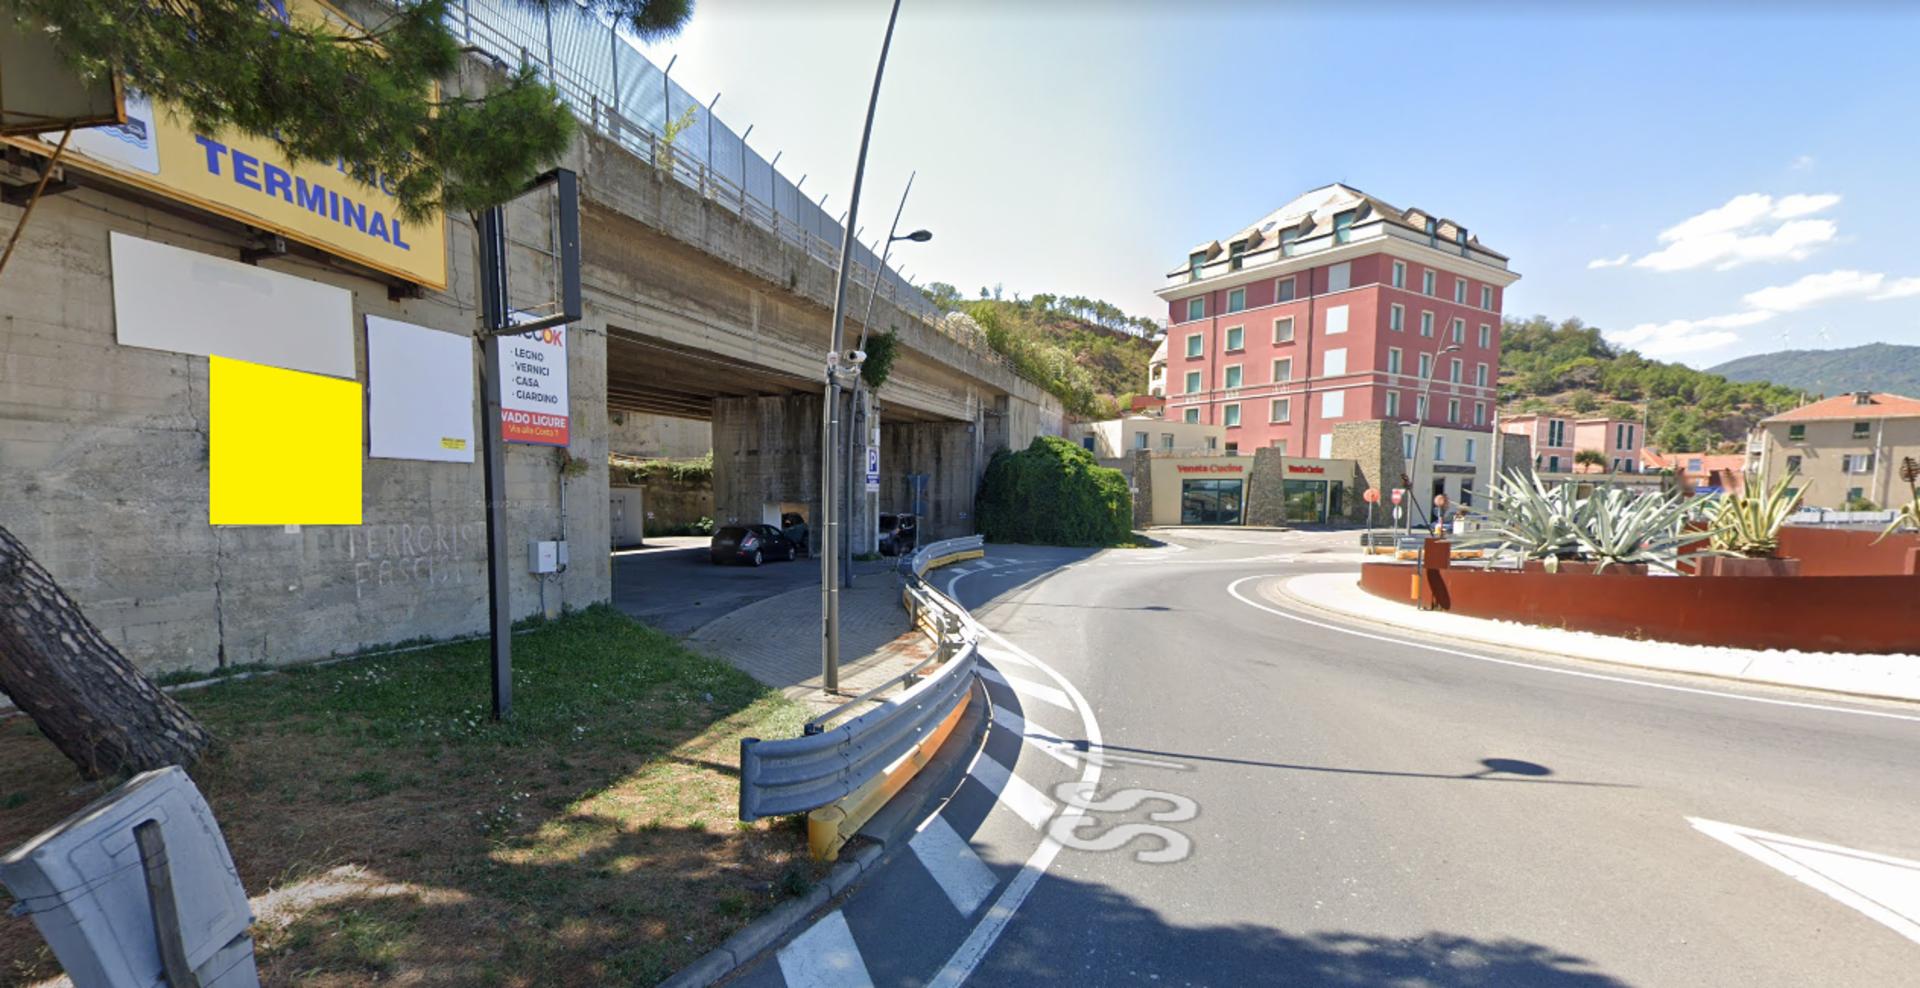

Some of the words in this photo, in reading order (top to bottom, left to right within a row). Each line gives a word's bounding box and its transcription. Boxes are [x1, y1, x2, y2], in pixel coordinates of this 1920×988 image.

[195, 133, 411, 251] TERMINAL
[514, 347, 544, 362] LEGNO
[515, 361, 550, 377] VERNICI
[515, 376, 540, 388] CASA
[516, 390, 559, 405] GIARDINO
[501, 410, 530, 424] VADO
[532, 414, 567, 428] LIGURE
[870, 451, 877, 470] P
[1176, 464, 1208, 474] Veneta
